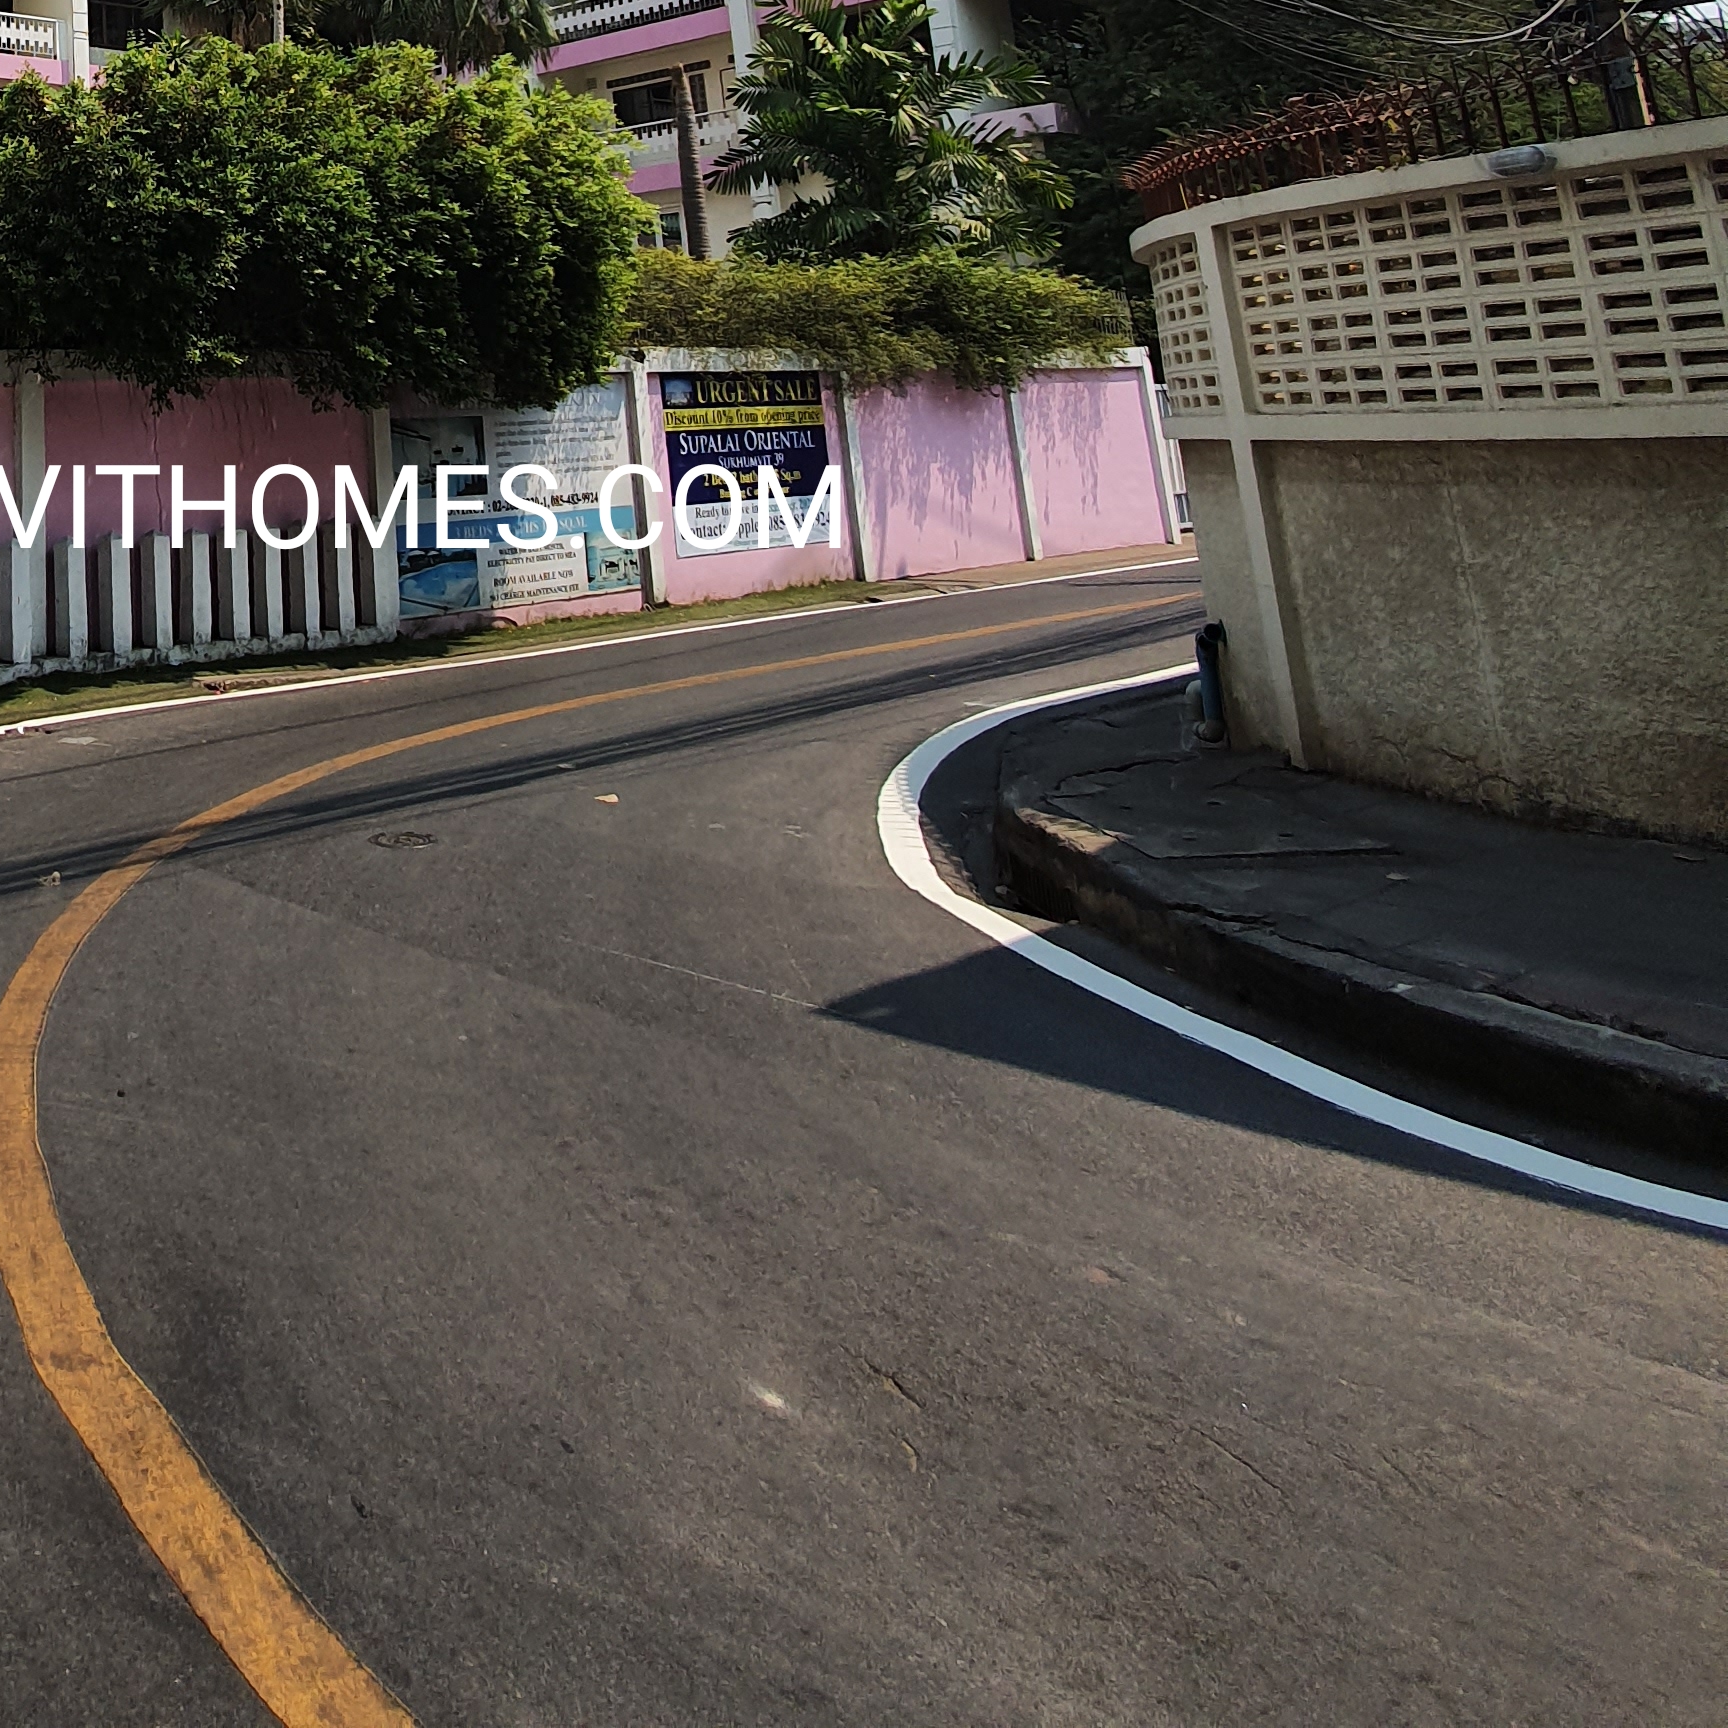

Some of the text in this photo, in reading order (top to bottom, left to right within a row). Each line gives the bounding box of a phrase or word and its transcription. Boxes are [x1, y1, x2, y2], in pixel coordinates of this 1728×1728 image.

[695, 377, 817, 404] URGENT SALE
[665, 409, 709, 426] Discount
[712, 408, 733, 424] 10%
[735, 408, 759, 423] from
[797, 407, 821, 423] price
[773, 452, 785, 465] 39
[695, 506, 719, 519] Ready
[493, 569, 574, 587] ROOM AVAILABLE NOW
[526, 585, 569, 597] MAINTENANCE
